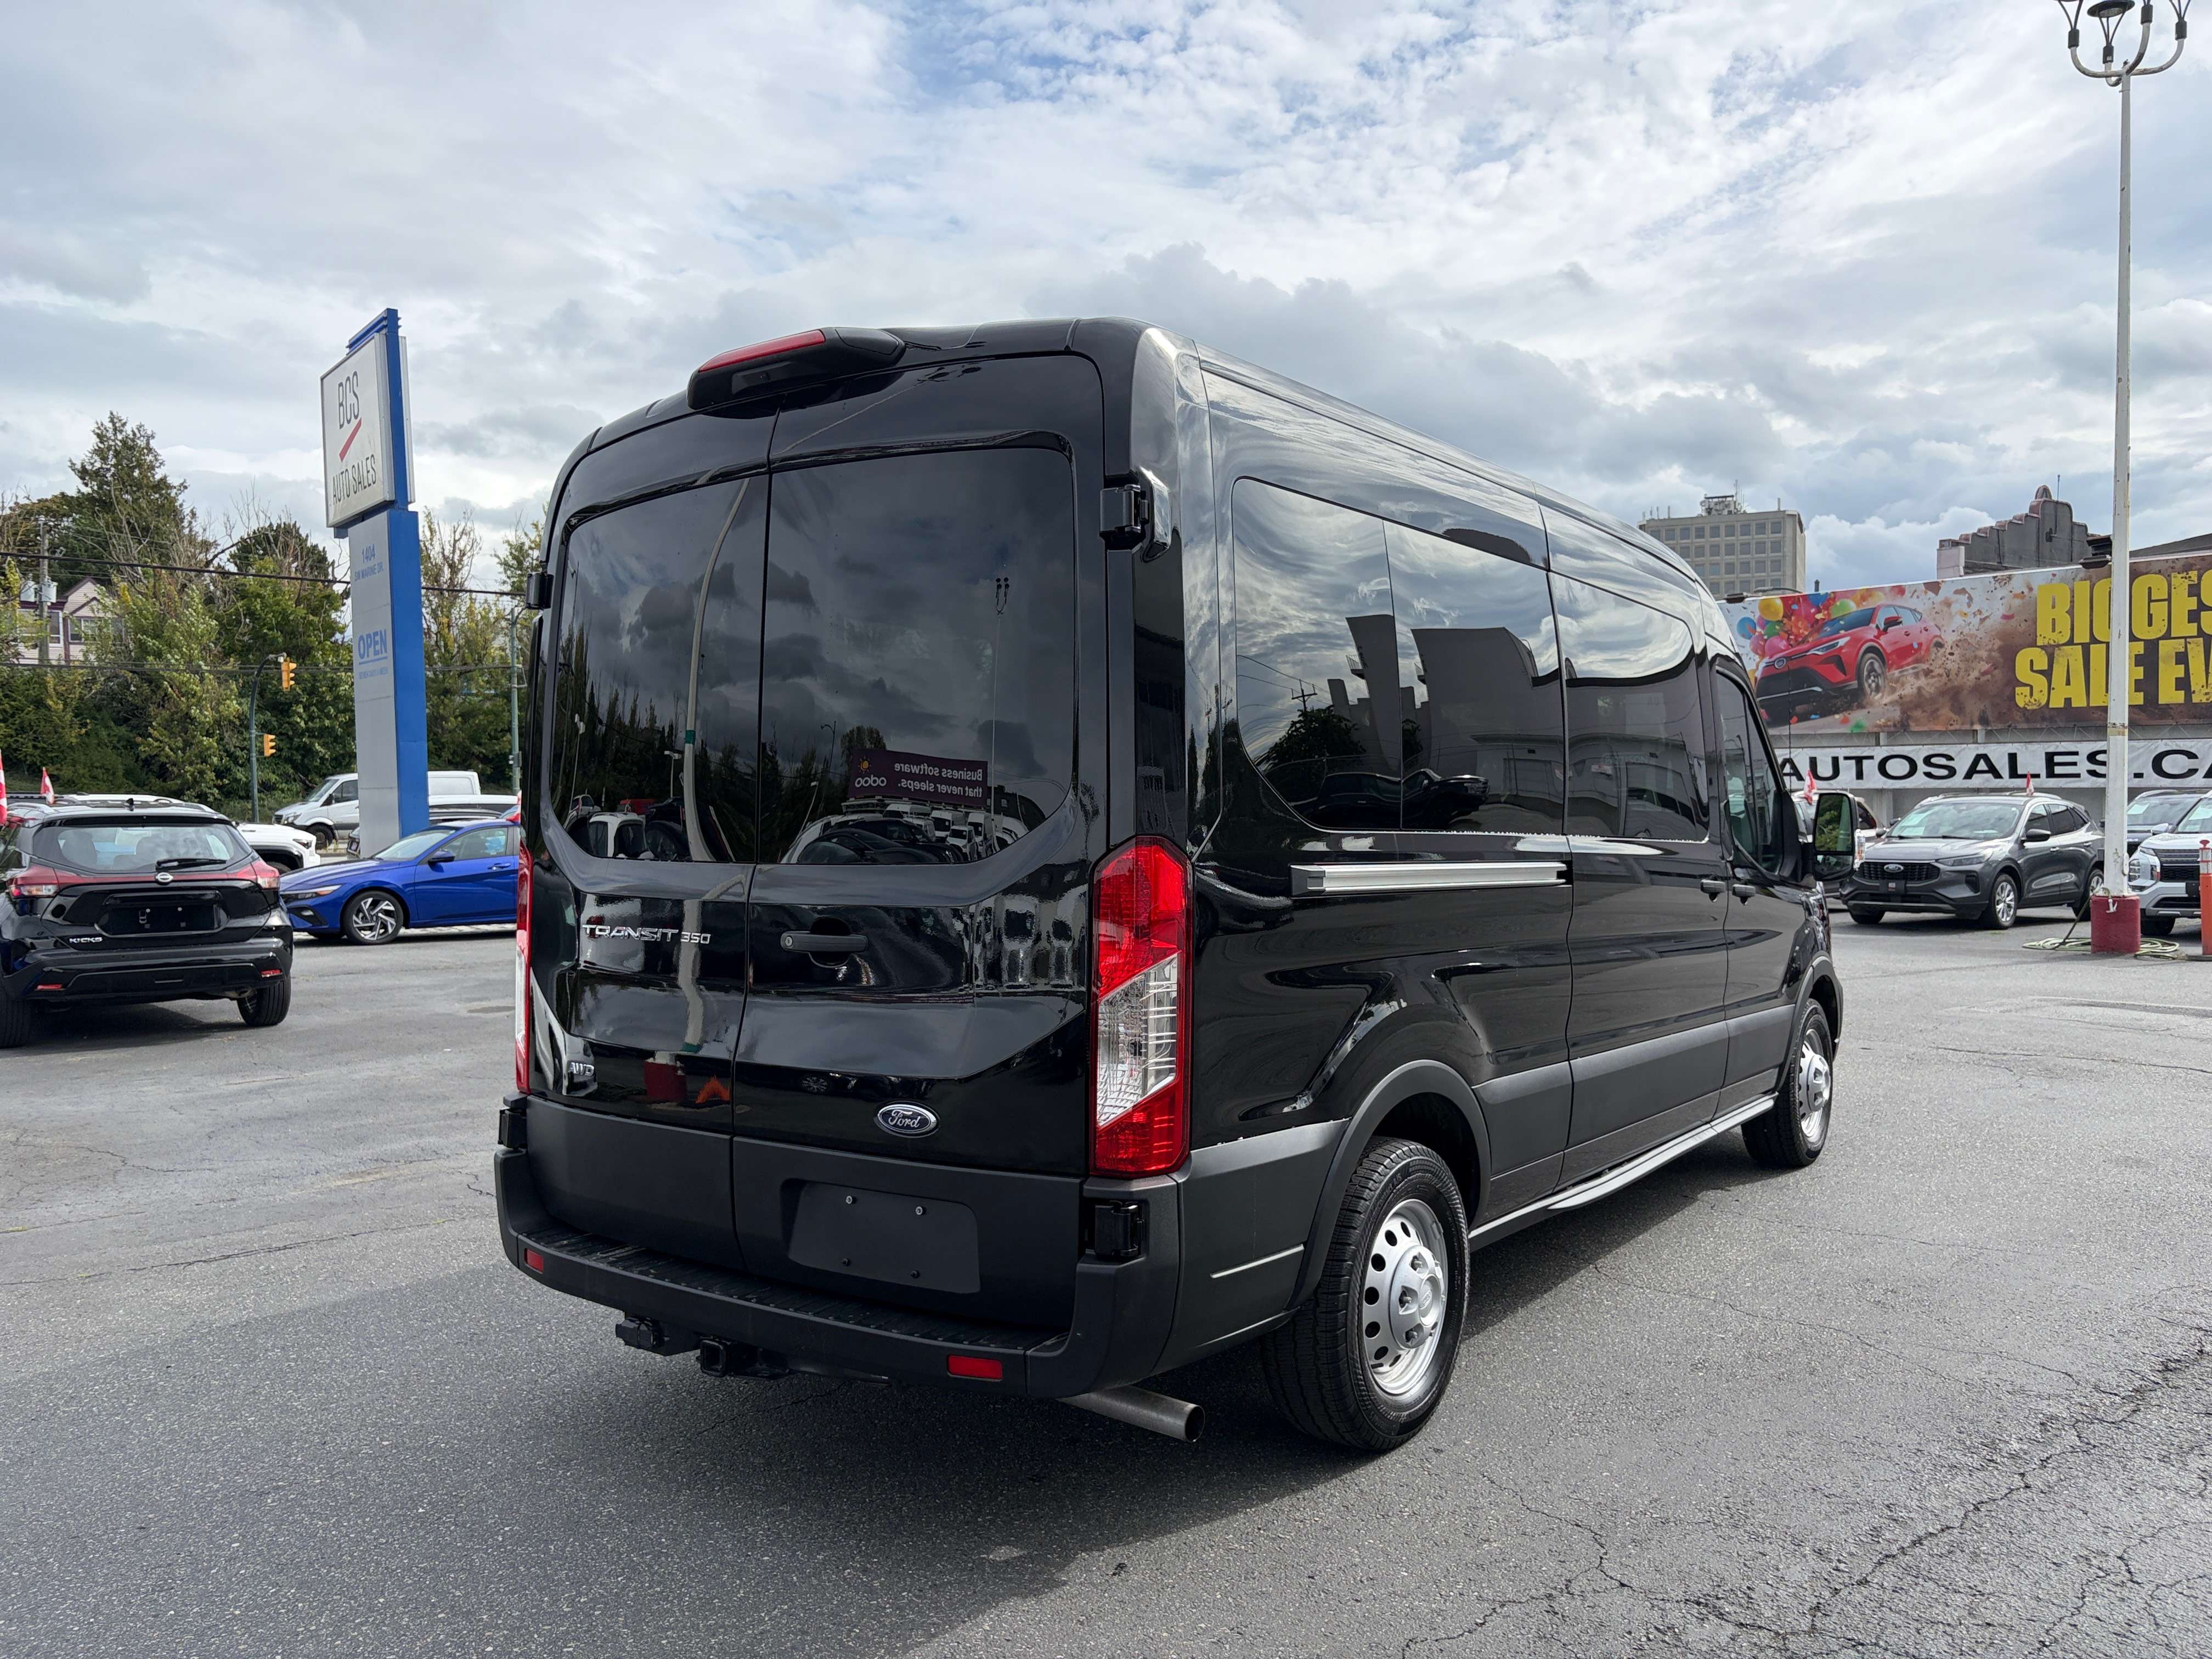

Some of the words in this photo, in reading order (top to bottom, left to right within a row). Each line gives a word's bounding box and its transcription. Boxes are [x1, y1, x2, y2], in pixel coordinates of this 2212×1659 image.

[337, 370, 360, 430] BCS
[332, 467, 350, 505] AUTO
[351, 454, 376, 495] SALES
[362, 544, 376, 563] 1404
[358, 629, 387, 659] OPEN
[1778, 749, 2212, 782] AUTOSALES.C
[582, 924, 679, 943] TRANSIT
[680, 932, 712, 945] 350
[568, 1061, 595, 1076] AWD
[888, 1109, 921, 1128] Ford
